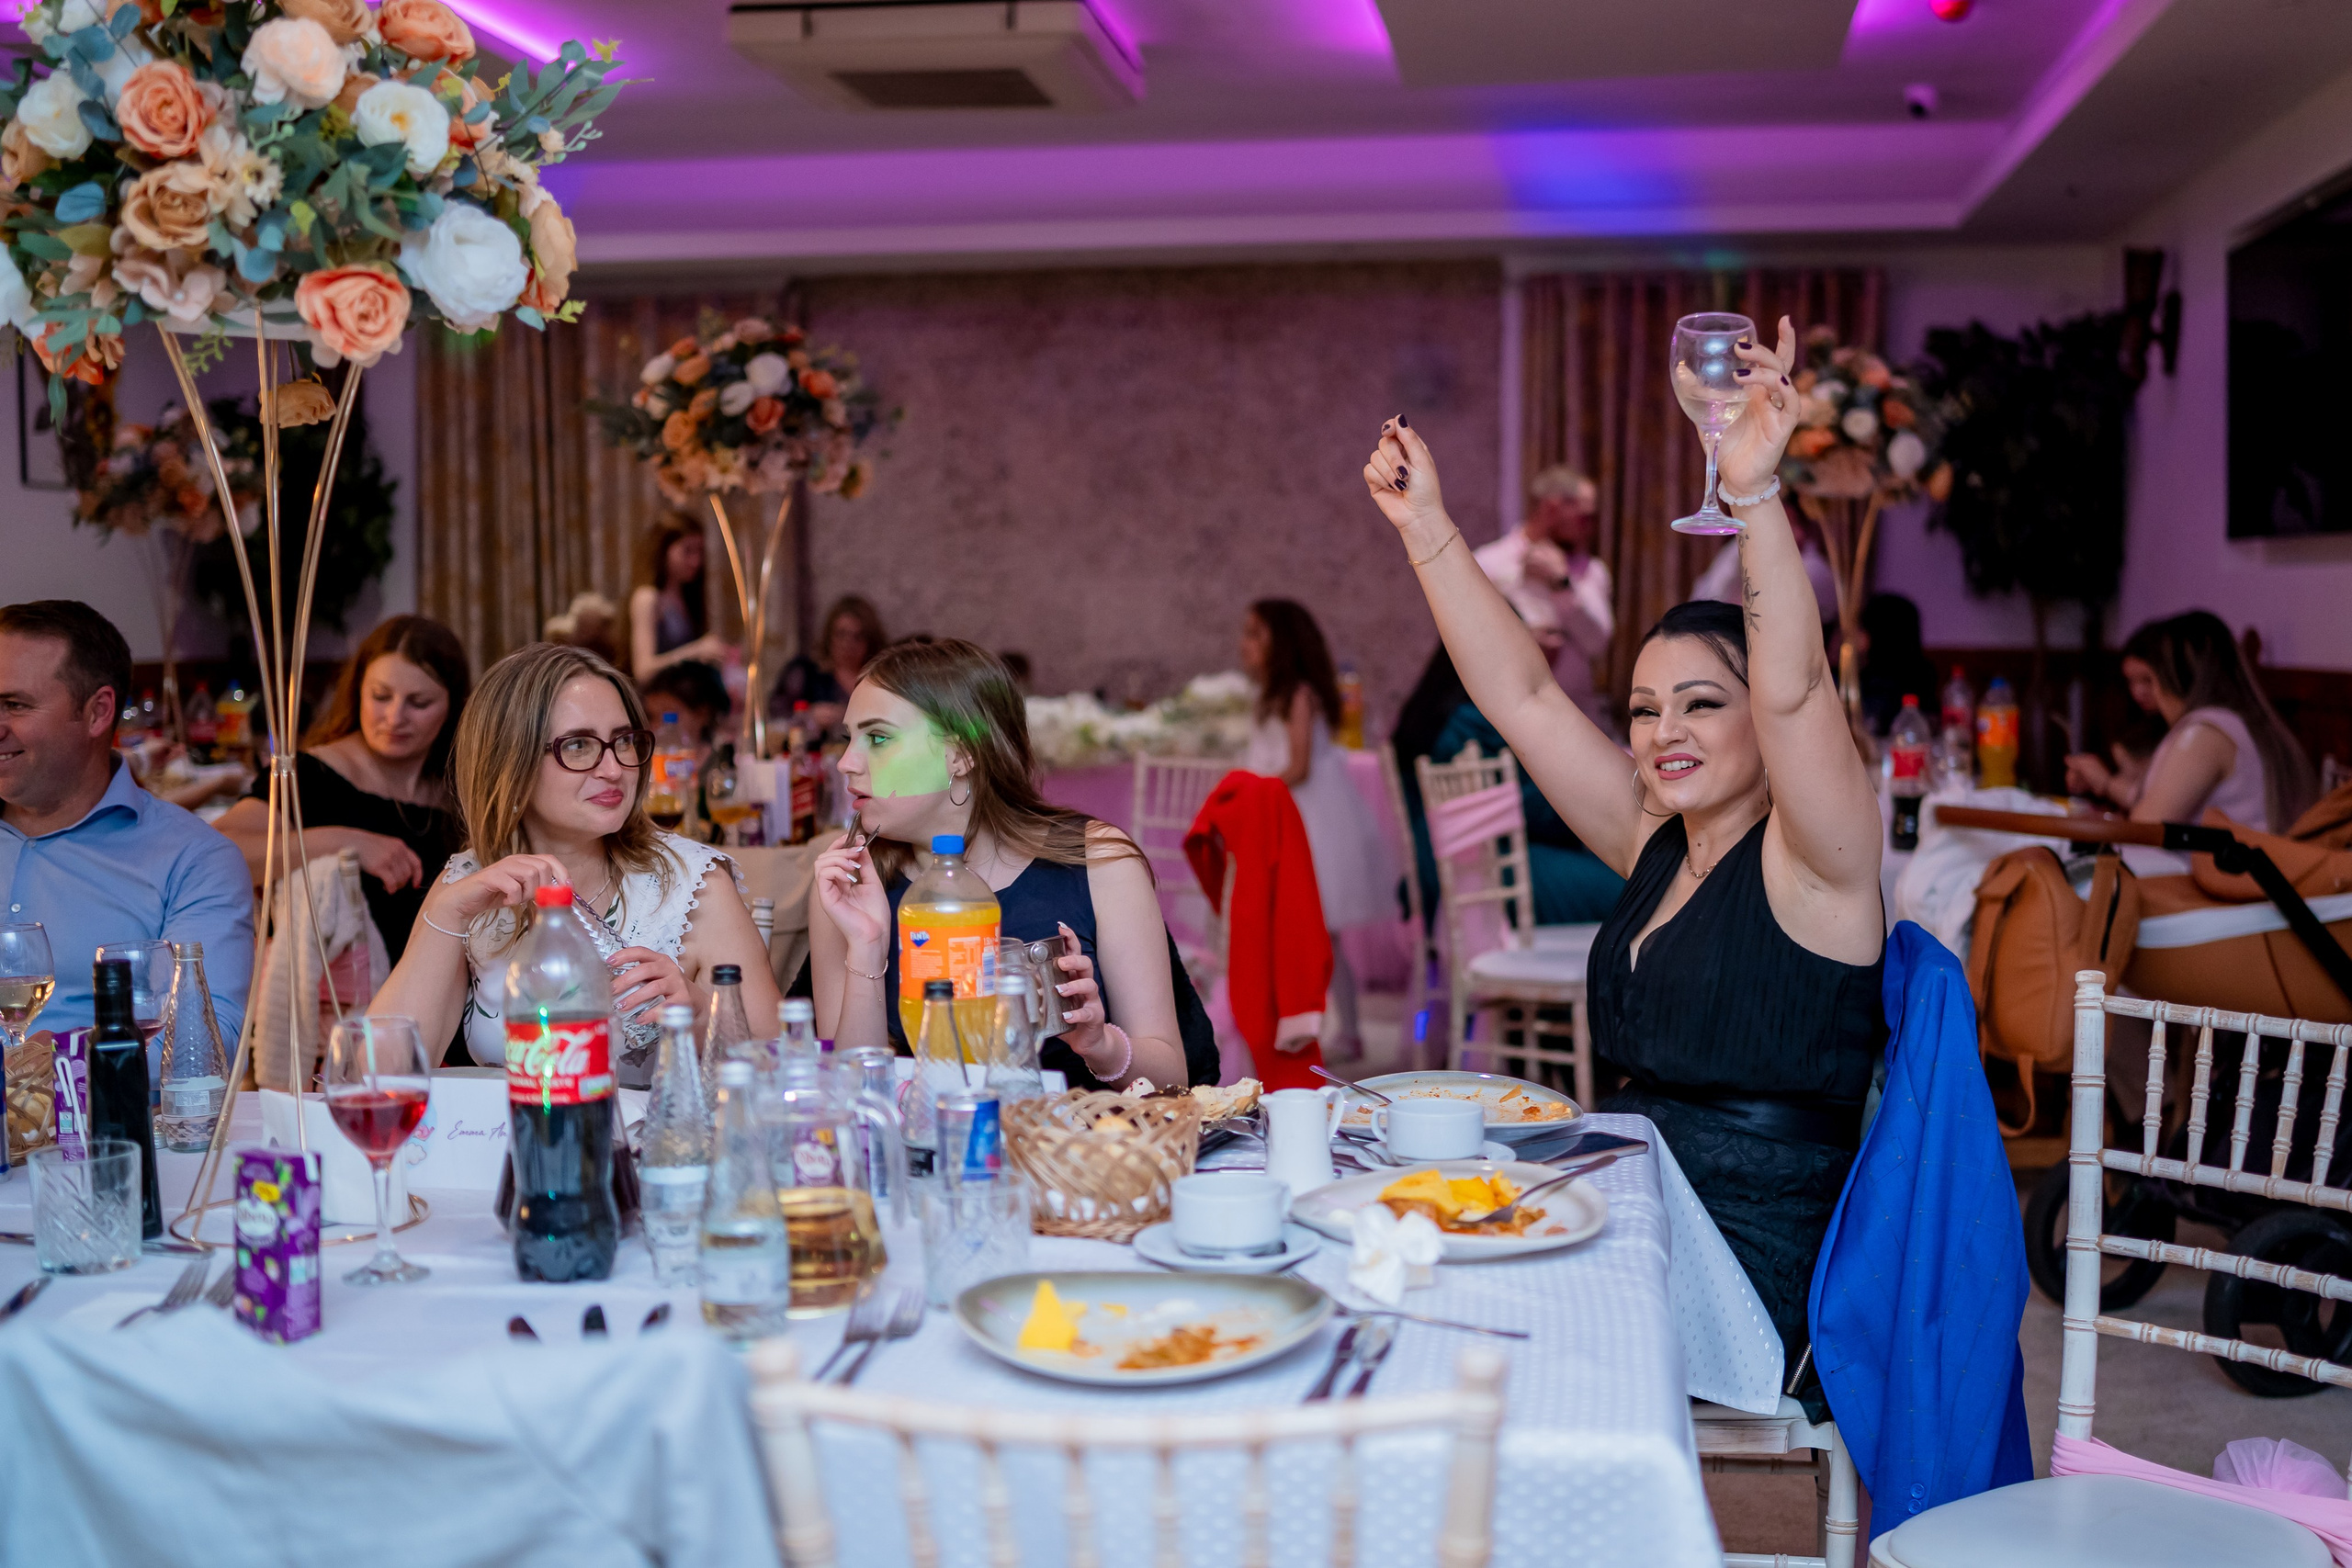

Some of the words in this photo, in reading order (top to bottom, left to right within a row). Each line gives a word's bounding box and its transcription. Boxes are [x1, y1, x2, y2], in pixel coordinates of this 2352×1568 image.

[910, 931, 930, 941] FANTA
[447, 1120, 486, 1140] Emma
[489, 1122, 507, 1141] An
